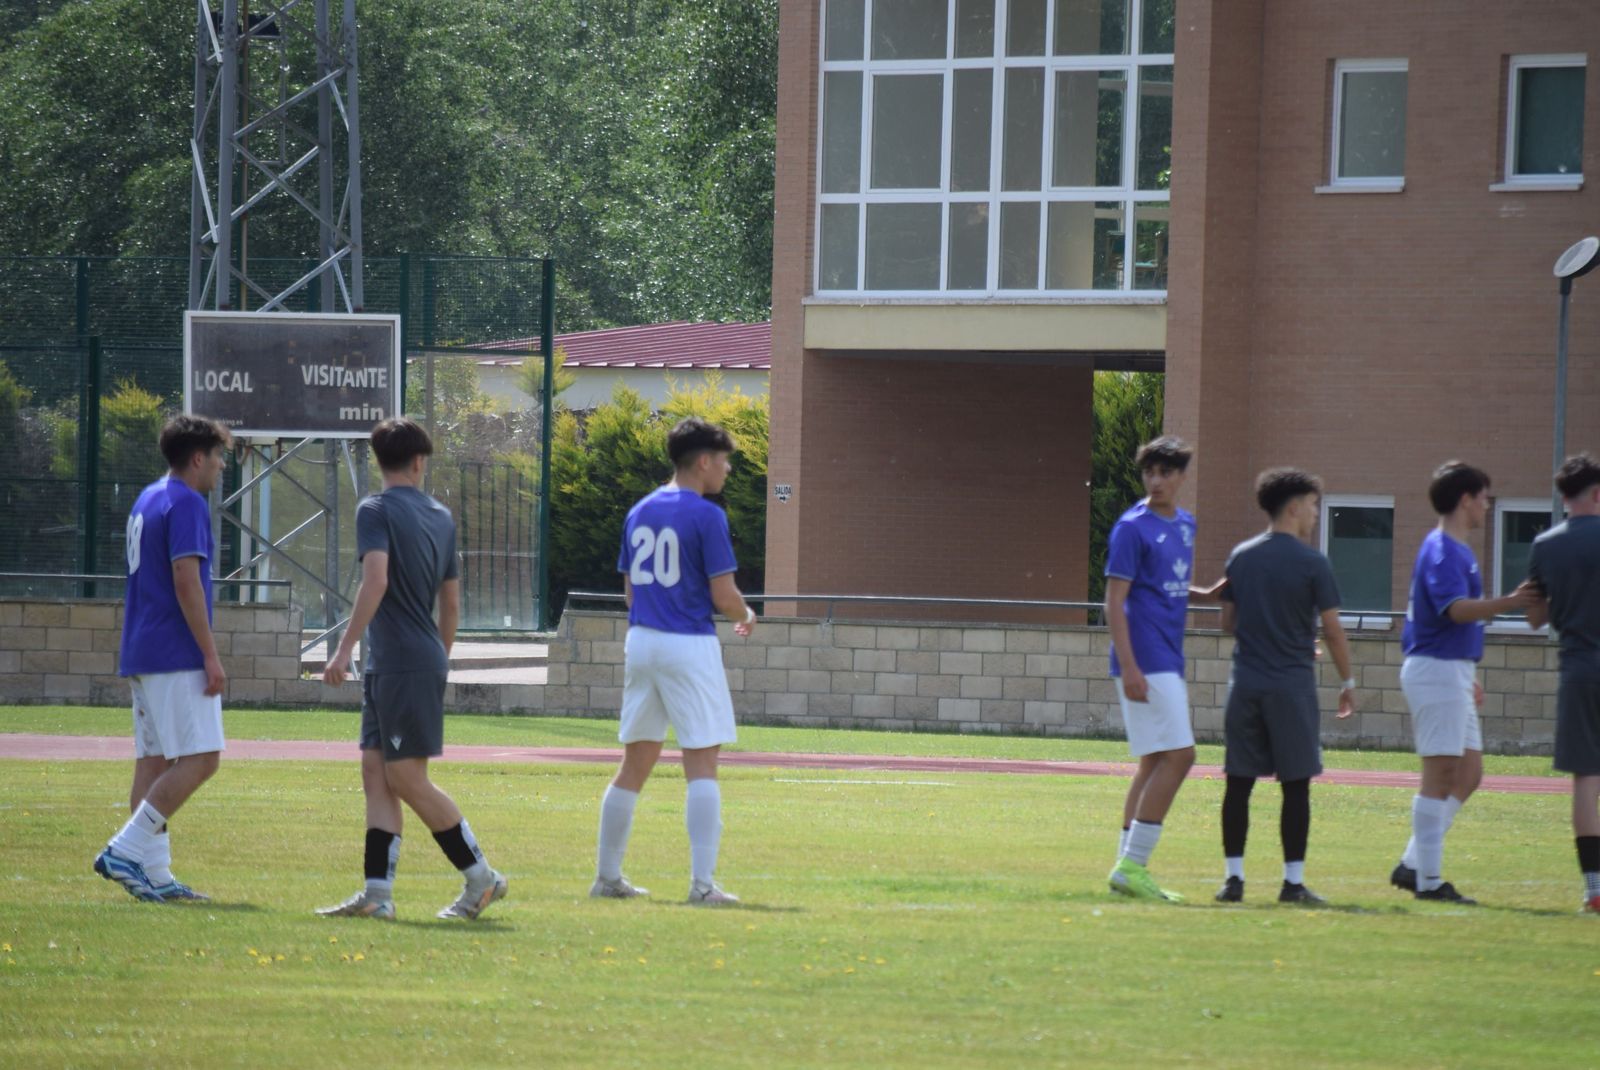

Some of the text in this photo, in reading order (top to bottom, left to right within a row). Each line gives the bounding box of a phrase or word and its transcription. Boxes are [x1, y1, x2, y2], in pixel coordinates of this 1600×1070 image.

[194, 370, 253, 393] LOCAL
[301, 364, 388, 389] VISITANTE
[339, 402, 384, 421] min
[774, 485, 792, 496] SALIDA
[630, 526, 681, 588] 20
